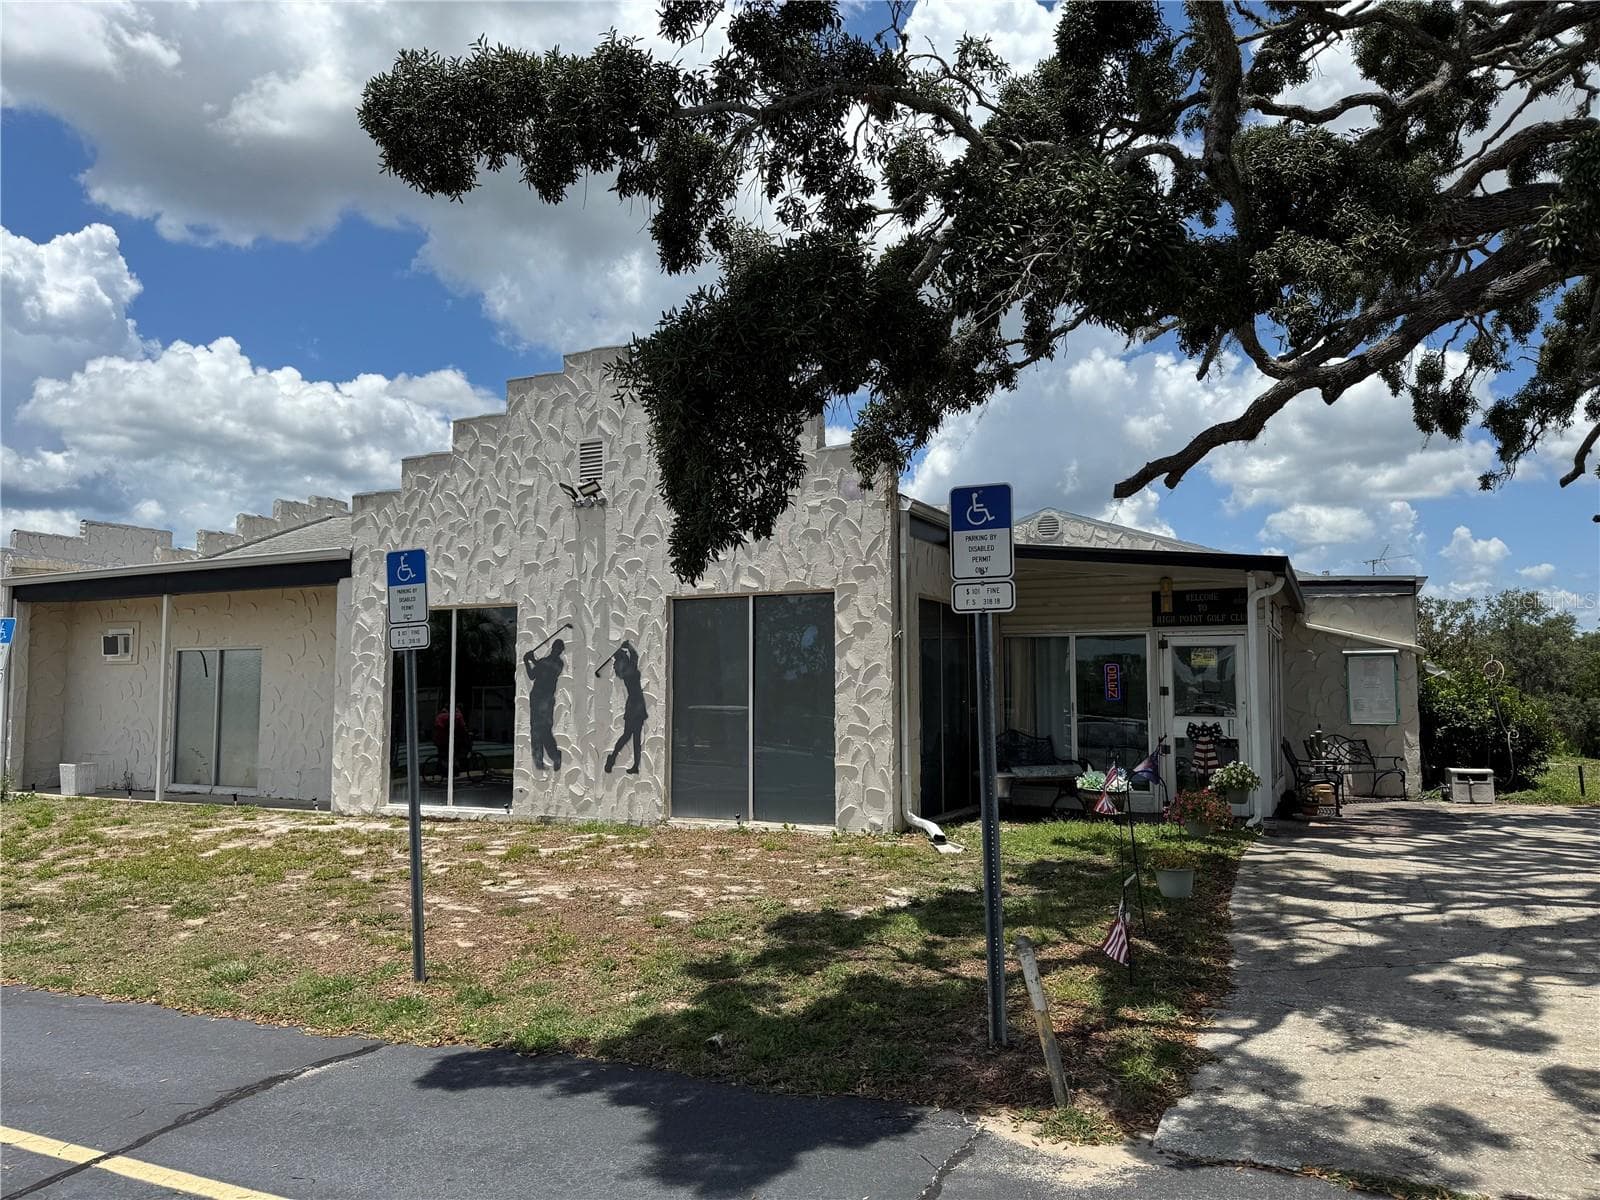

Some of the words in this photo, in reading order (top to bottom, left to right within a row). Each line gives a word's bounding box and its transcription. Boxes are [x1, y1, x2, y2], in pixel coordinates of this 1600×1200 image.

[965, 534, 988, 542] PARKING
[971, 555, 992, 563] PERMIT
[1185, 592, 1220, 601] WELCOME
[1197, 603, 1208, 613] TO
[1156, 614, 1176, 624] HIGH
[1179, 614, 1203, 623] POINT
[1207, 613, 1227, 622] GOLF
[1230, 612, 1248, 622] CLU
[1107, 665, 1118, 698] OPEN
